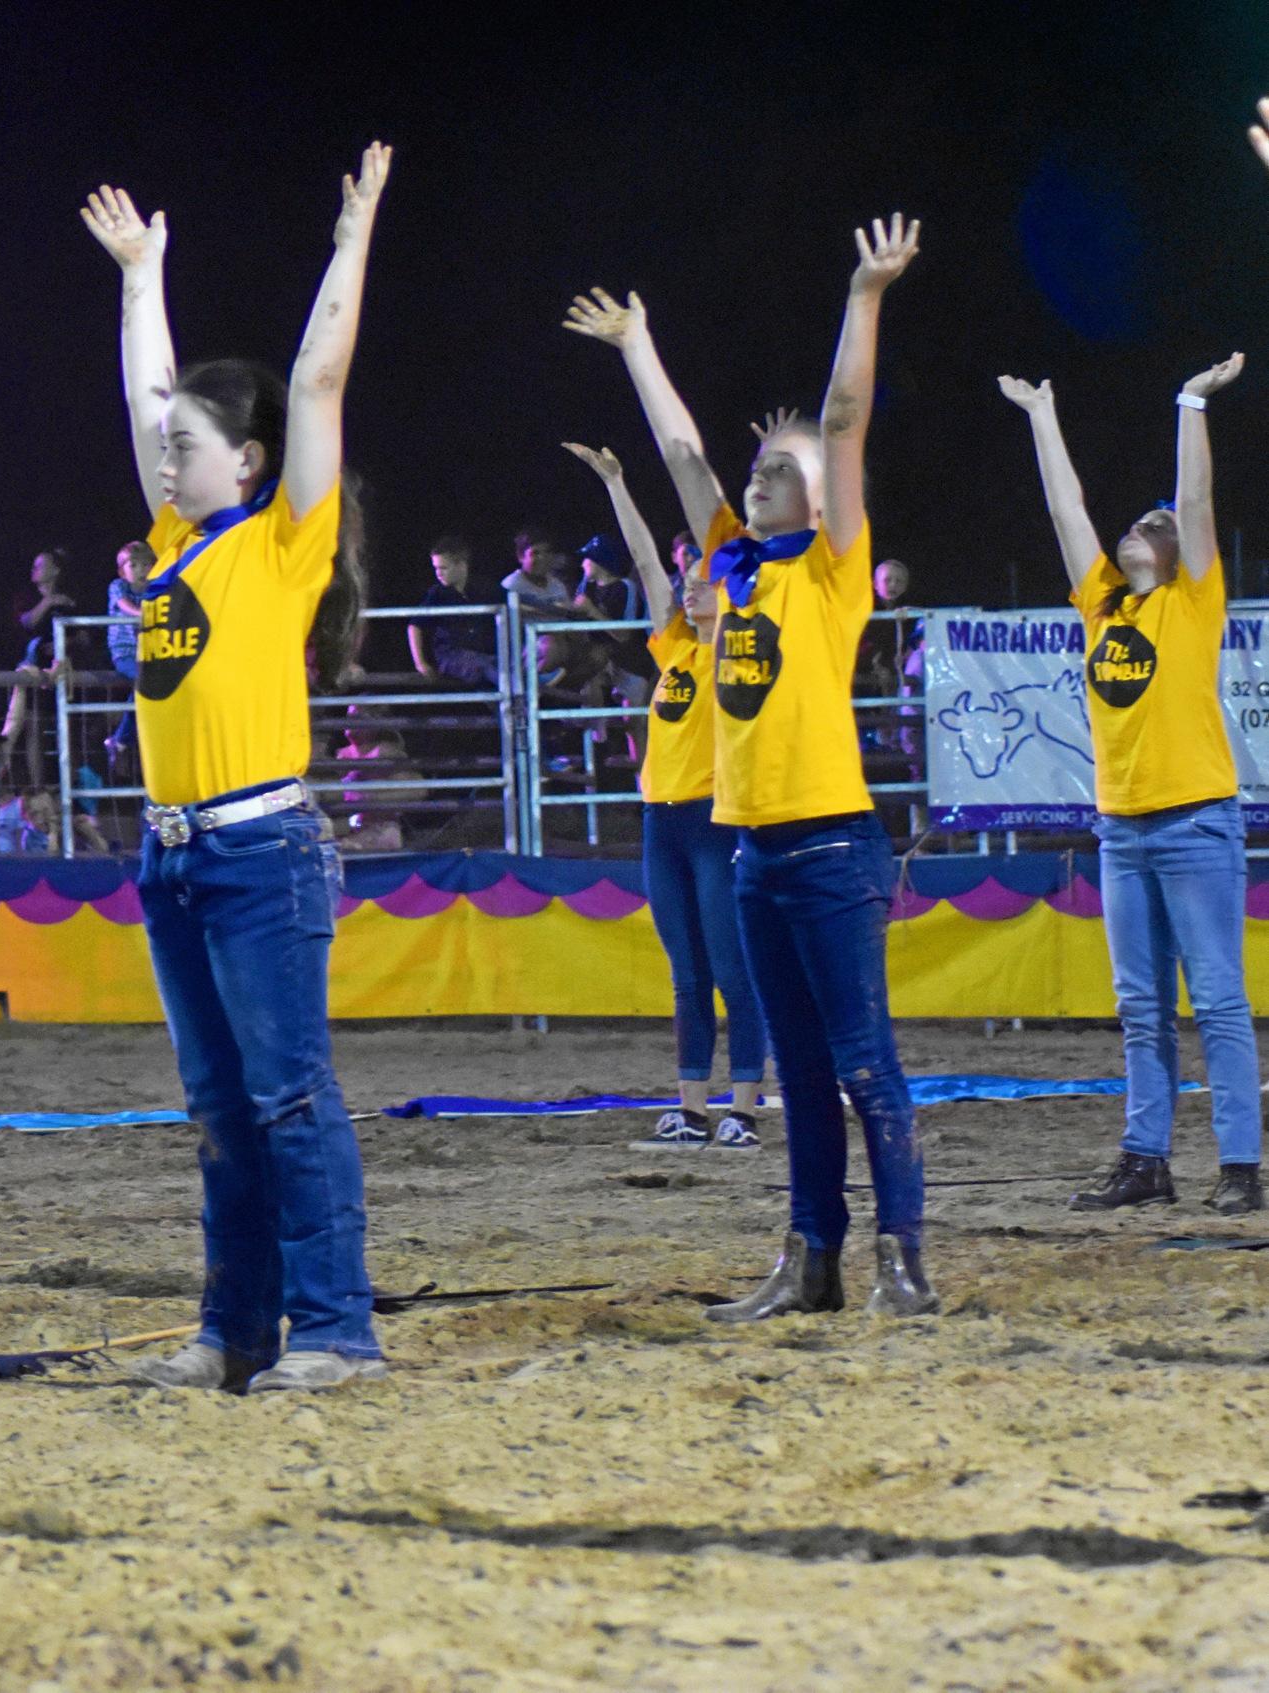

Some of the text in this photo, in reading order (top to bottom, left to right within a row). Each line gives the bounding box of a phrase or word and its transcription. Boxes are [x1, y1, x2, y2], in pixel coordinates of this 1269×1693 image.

[724, 629, 757, 655] THE
[1231, 681, 1252, 696] 32
[1001, 811, 1075, 824] SERVICING
